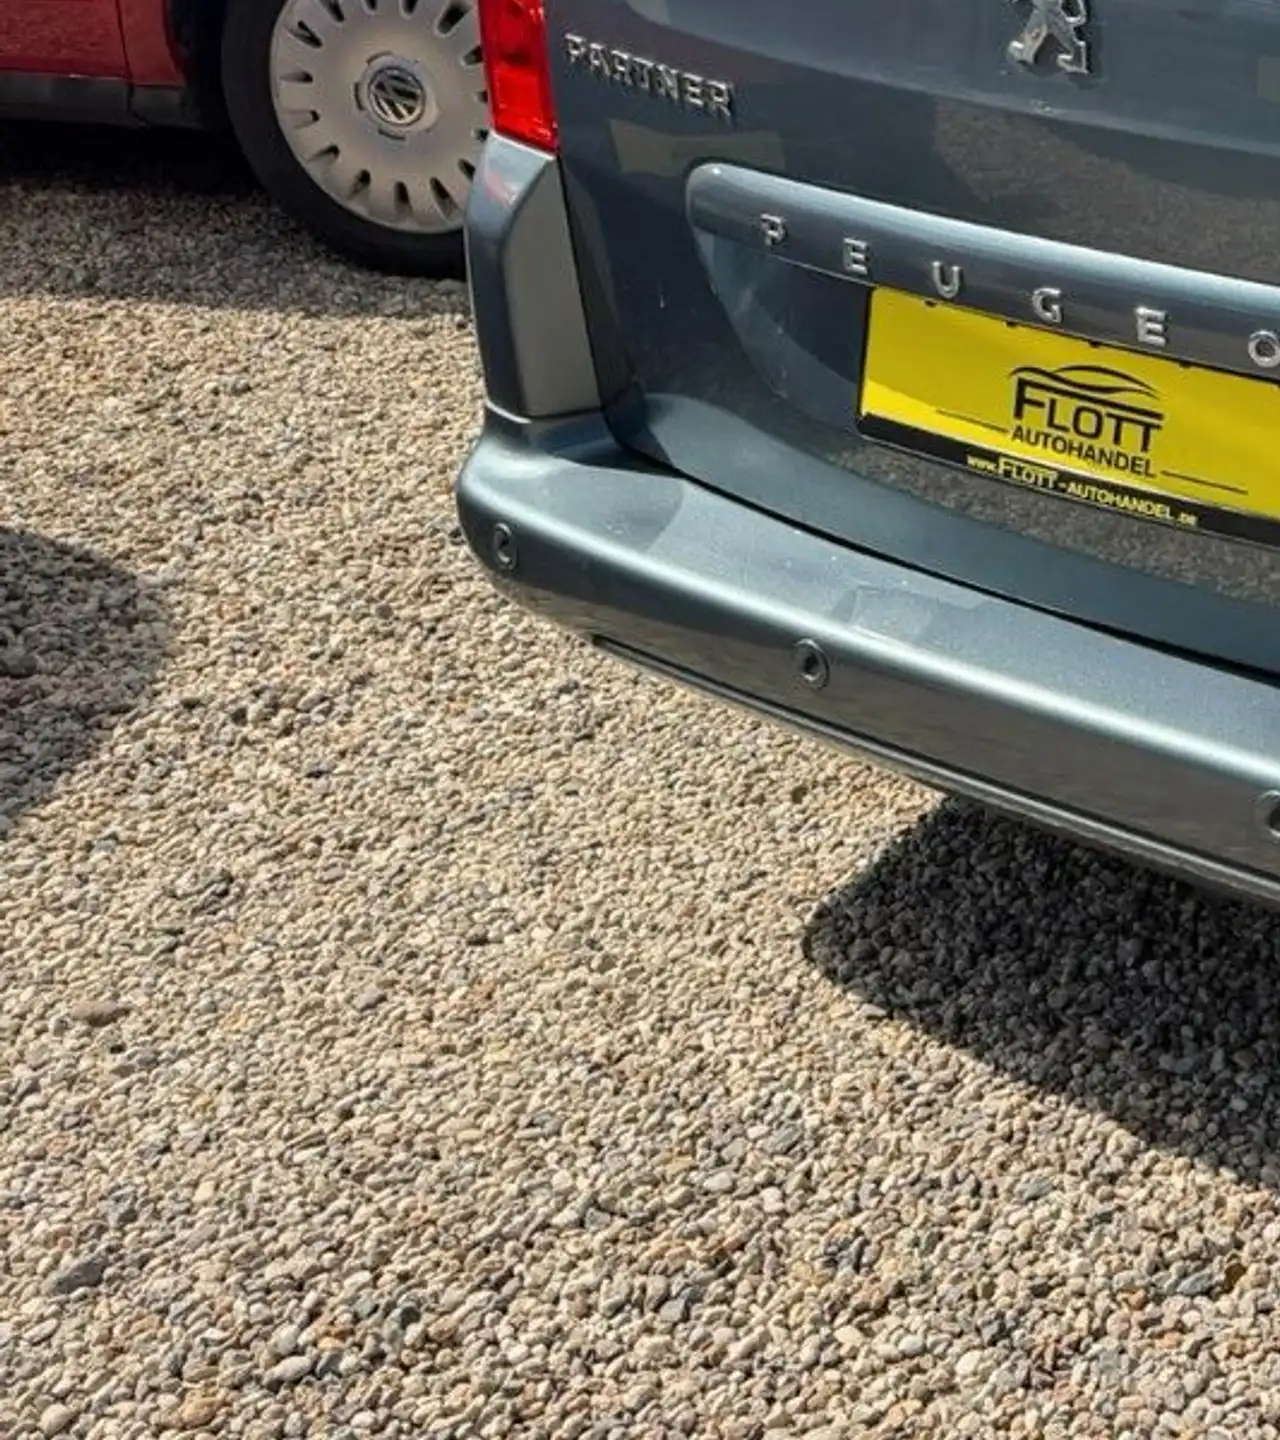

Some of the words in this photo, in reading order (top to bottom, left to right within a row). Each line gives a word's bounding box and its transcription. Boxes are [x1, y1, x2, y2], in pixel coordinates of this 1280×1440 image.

[565, 32, 732, 117] PARTNER
[1010, 423, 1156, 479] AUTOHANDEL
[1011, 376, 1164, 454] FLOTT
